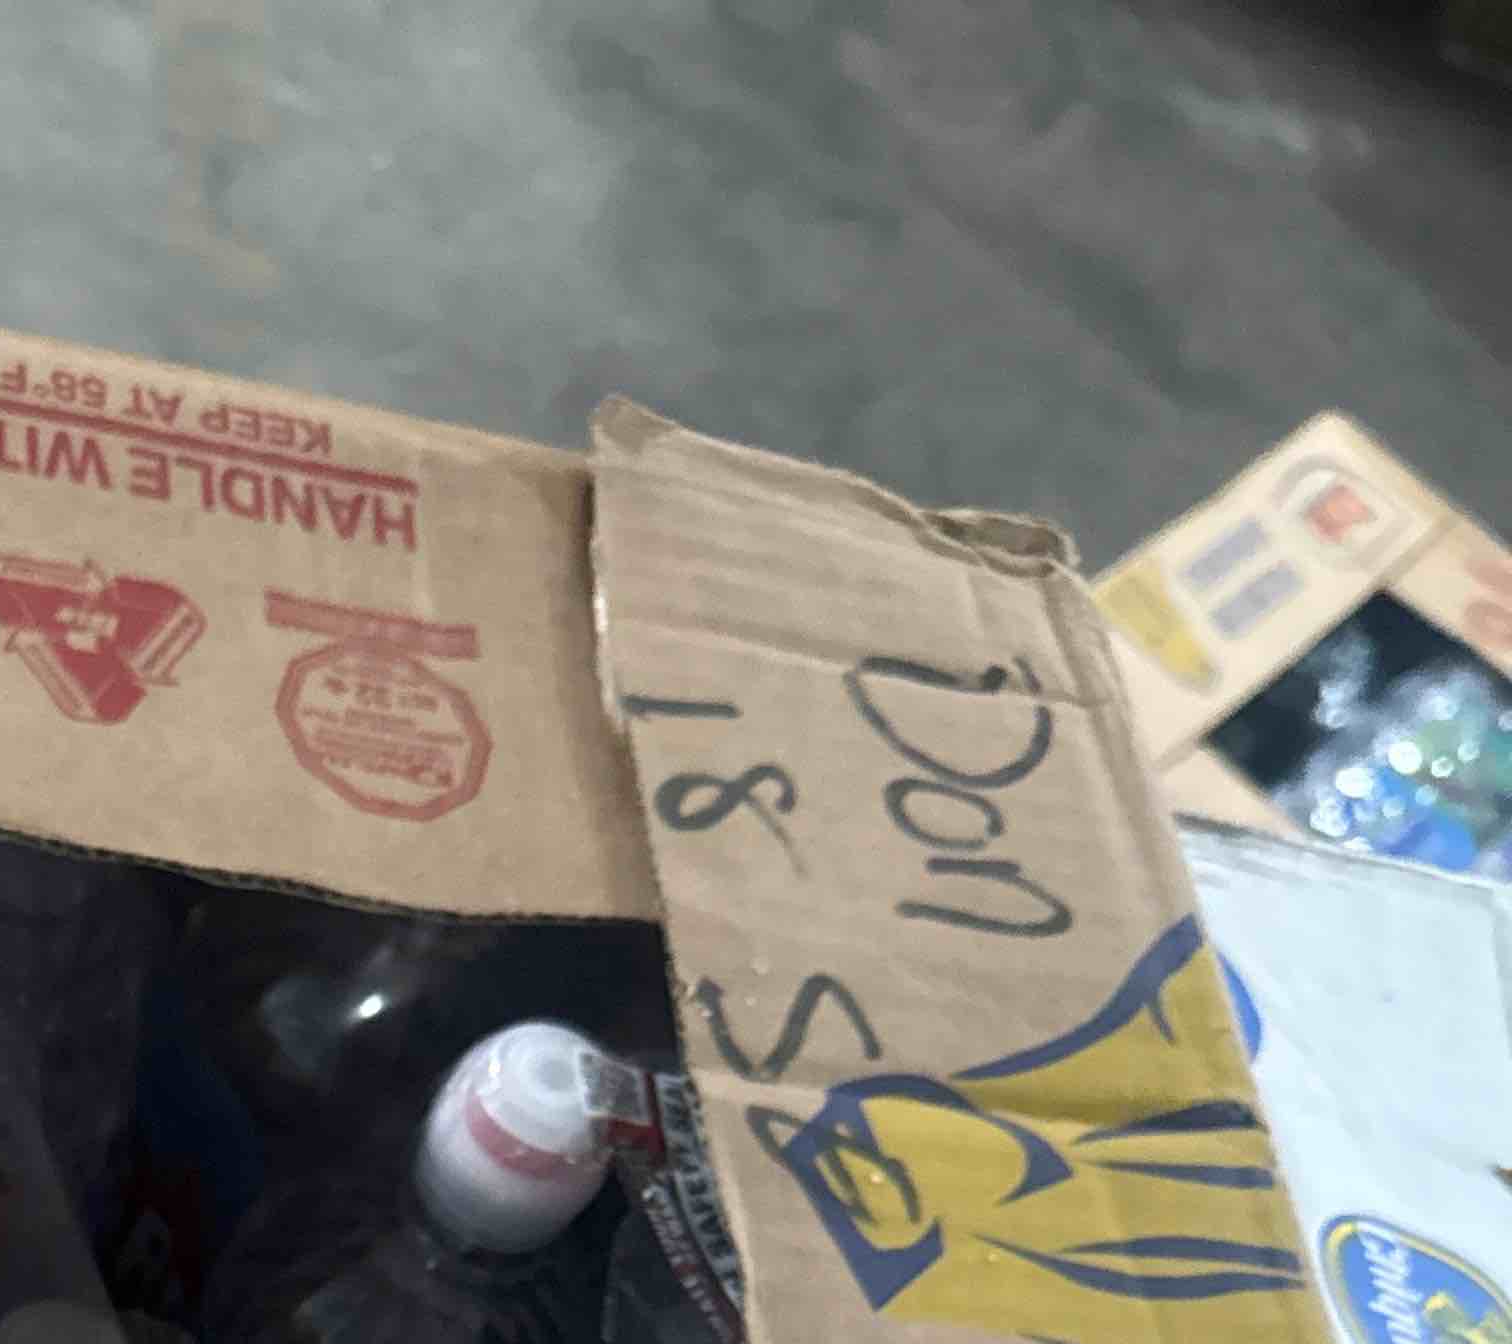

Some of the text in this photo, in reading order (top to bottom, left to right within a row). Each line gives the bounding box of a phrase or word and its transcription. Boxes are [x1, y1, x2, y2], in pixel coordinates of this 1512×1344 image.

[122, 383, 185, 425] AT
[199, 404, 332, 454] KEEP
[126, 445, 417, 551] HANDLE
